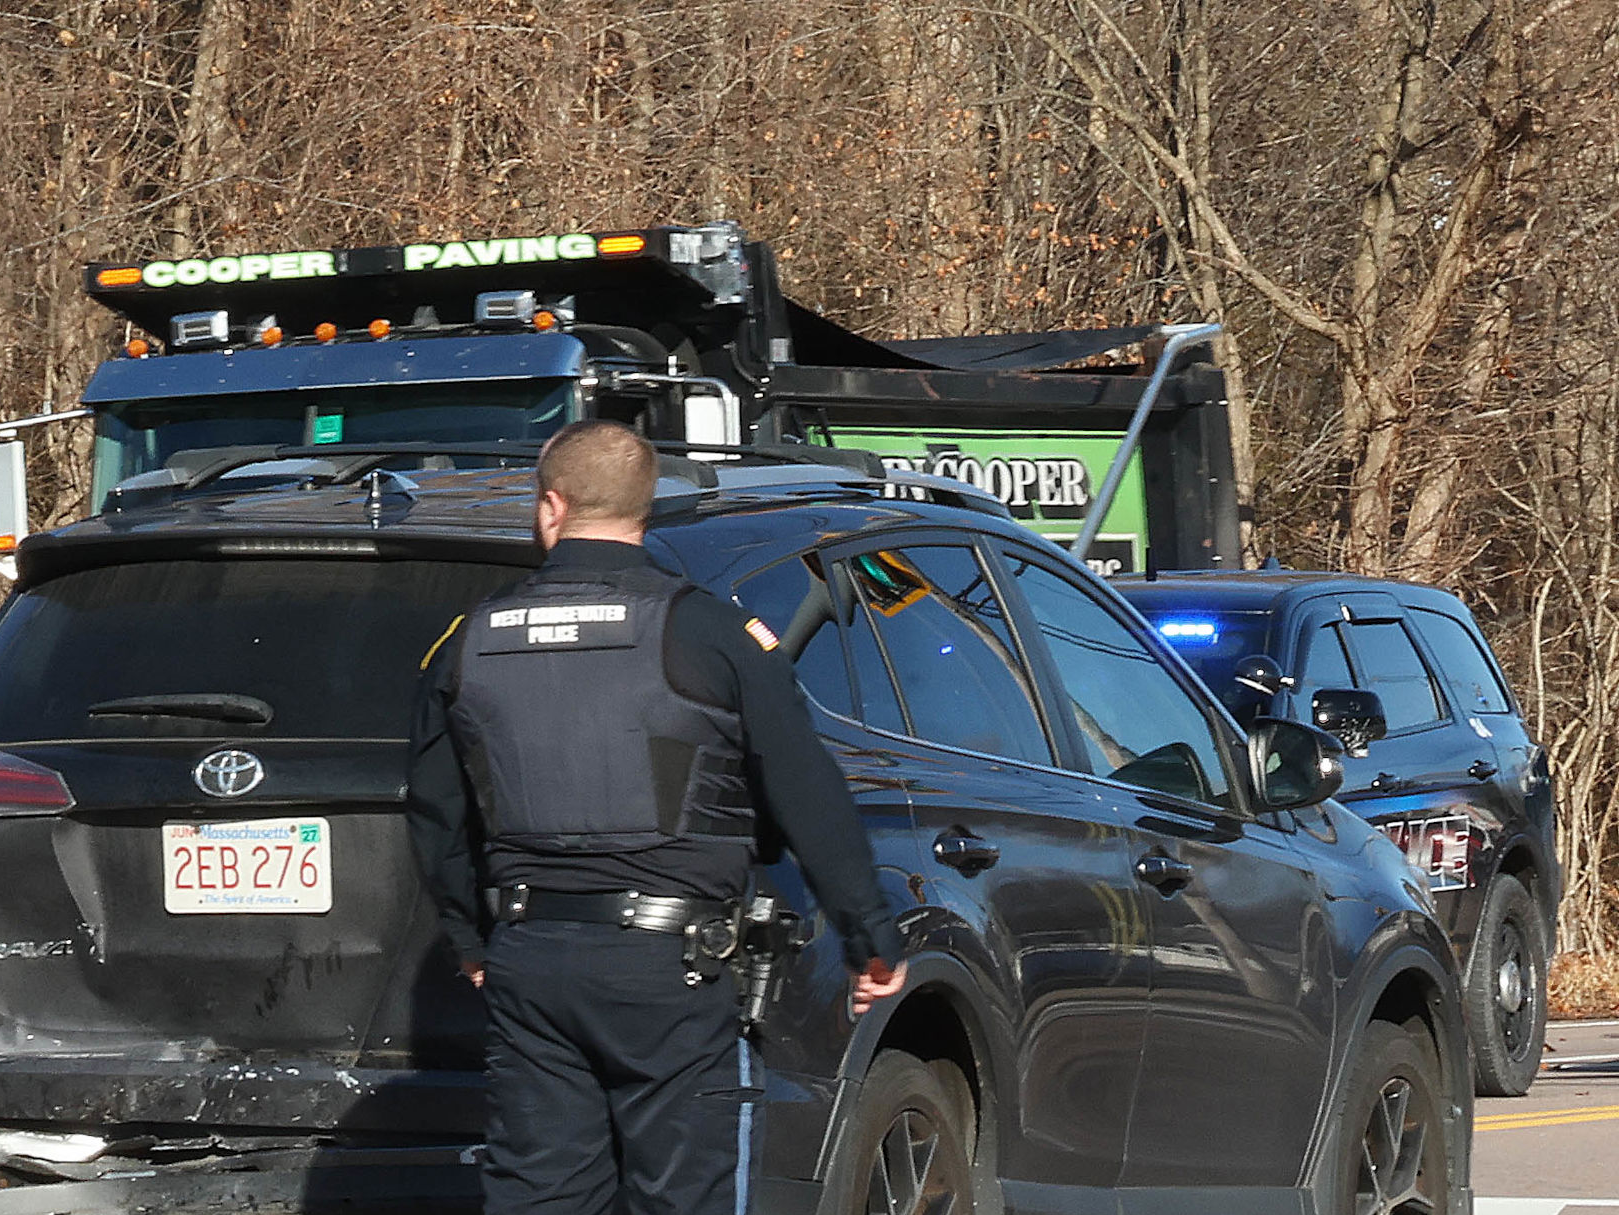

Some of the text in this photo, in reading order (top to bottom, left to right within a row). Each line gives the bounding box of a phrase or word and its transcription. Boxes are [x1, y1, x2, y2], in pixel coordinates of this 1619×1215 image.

[142, 233, 597, 288] COOPER PAVING
[933, 457, 1089, 506] COOPER
[527, 624, 580, 645] POLICE
[174, 845, 318, 889] 2EB 276
